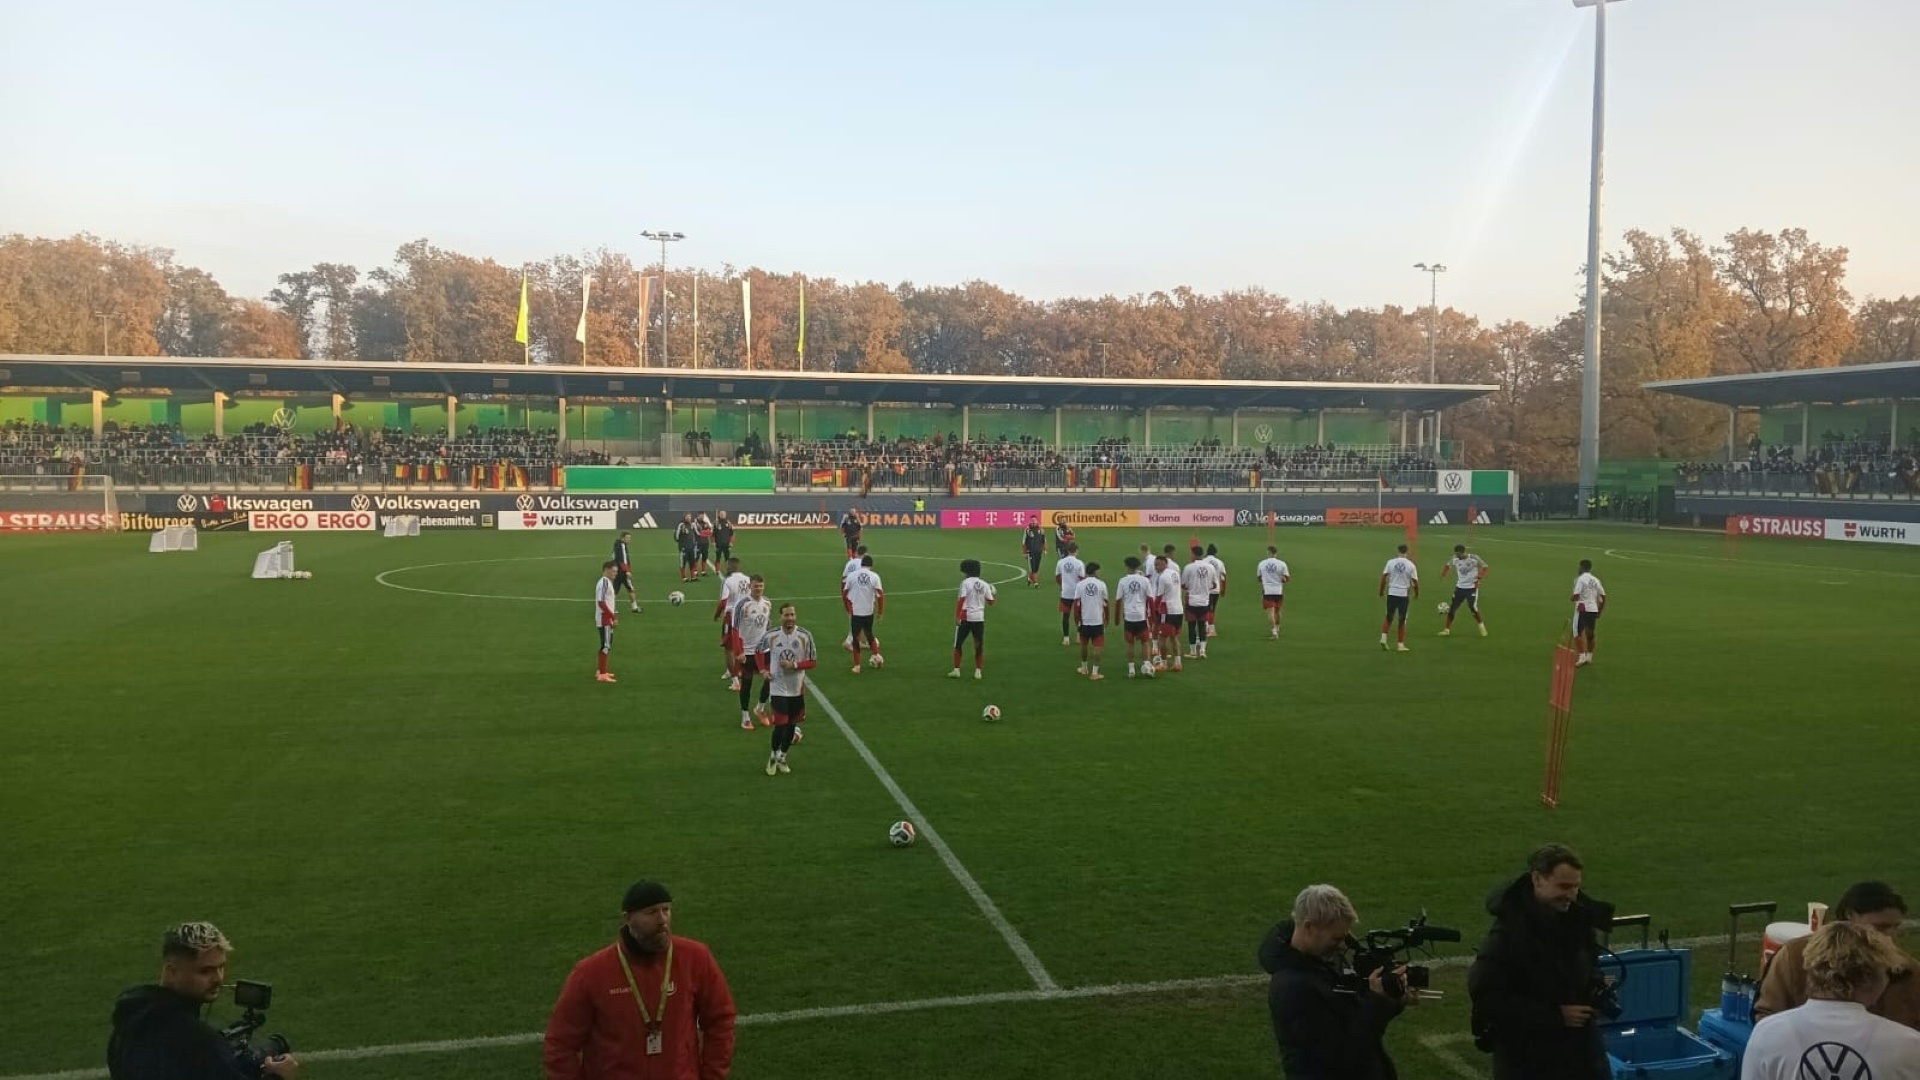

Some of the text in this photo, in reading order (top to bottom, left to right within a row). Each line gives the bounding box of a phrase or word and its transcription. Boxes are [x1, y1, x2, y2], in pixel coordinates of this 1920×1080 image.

[374, 495, 481, 511] Volkswagen
[538, 495, 639, 511] Volkswagen
[253, 513, 309, 529] ERGO
[317, 513, 371, 529] ERGO
[541, 515, 593, 525] WÜRTH
[738, 512, 830, 525] DEUTSCHLAND
[958, 511, 1025, 526] T T T
[1149, 513, 1224, 523] Klarna Klarna
[1255, 512, 1324, 526] Vokswagen
[1753, 517, 1822, 537] STRAUSS
[1860, 526, 1906, 539] WÜRTH
